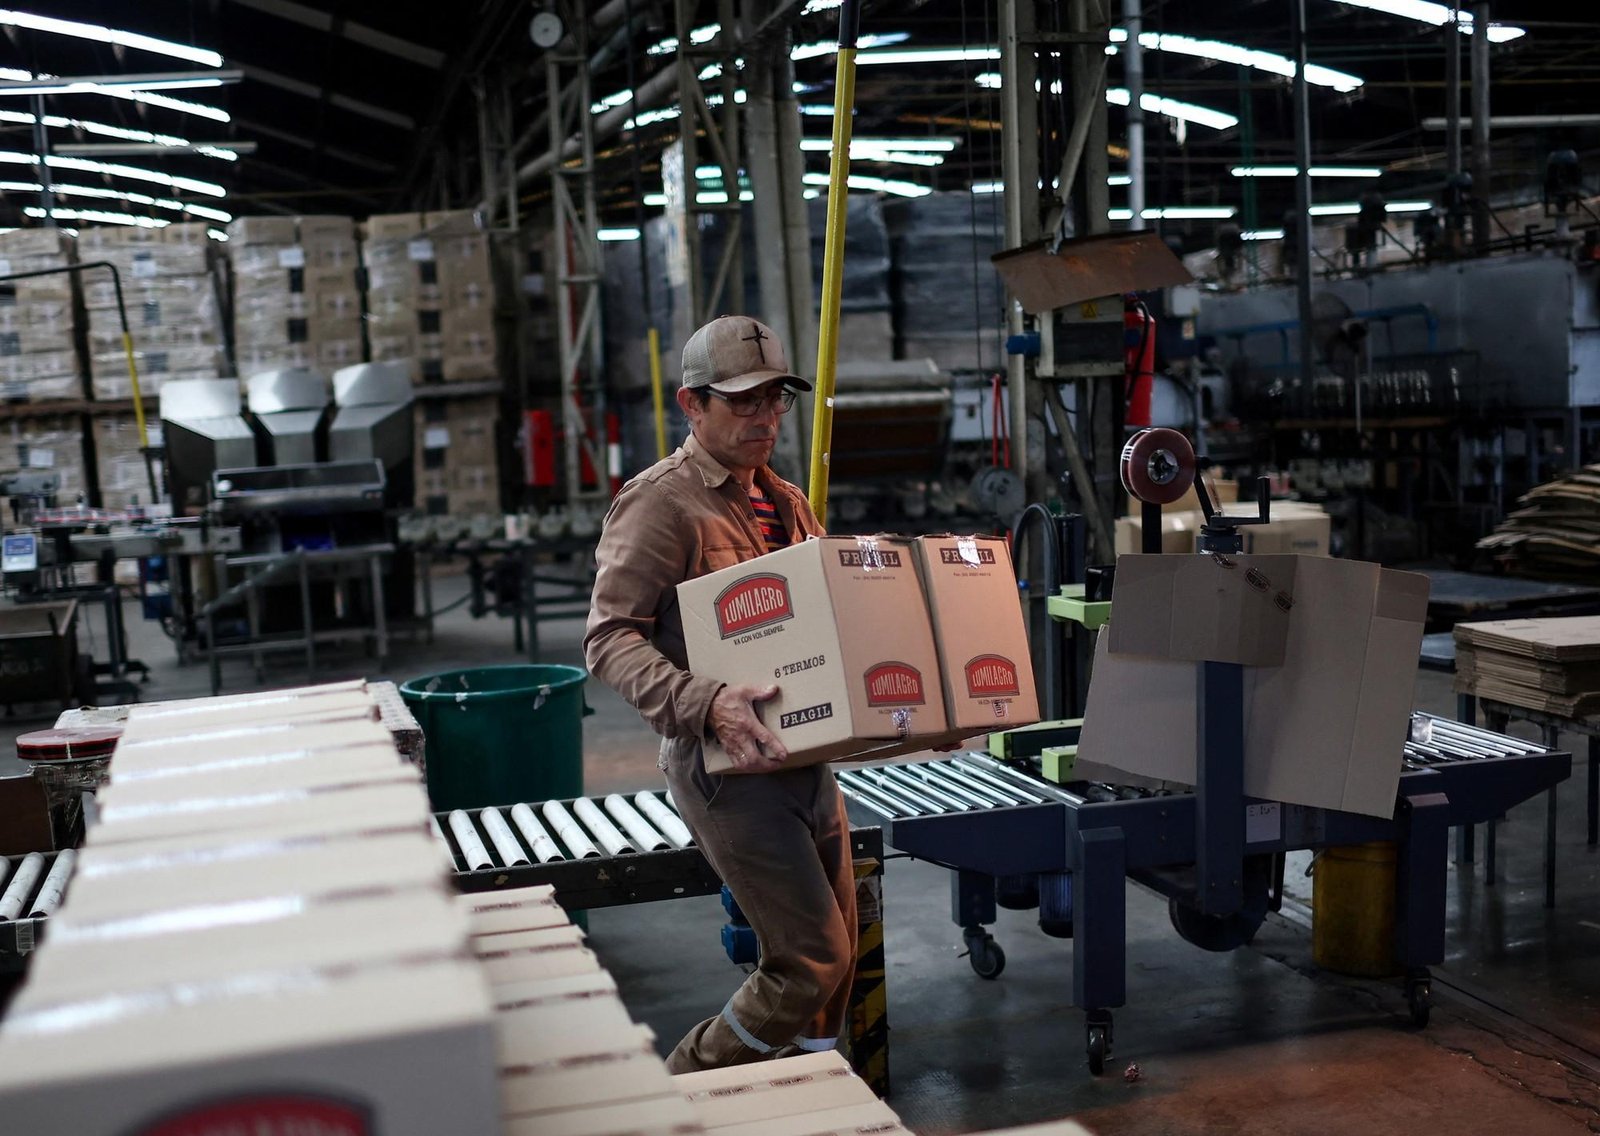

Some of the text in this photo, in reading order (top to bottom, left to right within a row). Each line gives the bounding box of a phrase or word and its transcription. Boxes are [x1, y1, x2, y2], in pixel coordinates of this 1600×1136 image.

[942, 550, 993, 562] FRIL
[724, 586, 784, 624] LUMILAGRO
[741, 635, 752, 643] CON
[774, 654, 826, 679] 6 TERMOS
[972, 665, 1014, 687] LUMILAGRO
[872, 672, 918, 696] LUMILAGRO
[782, 705, 831, 727] FRAGIL
